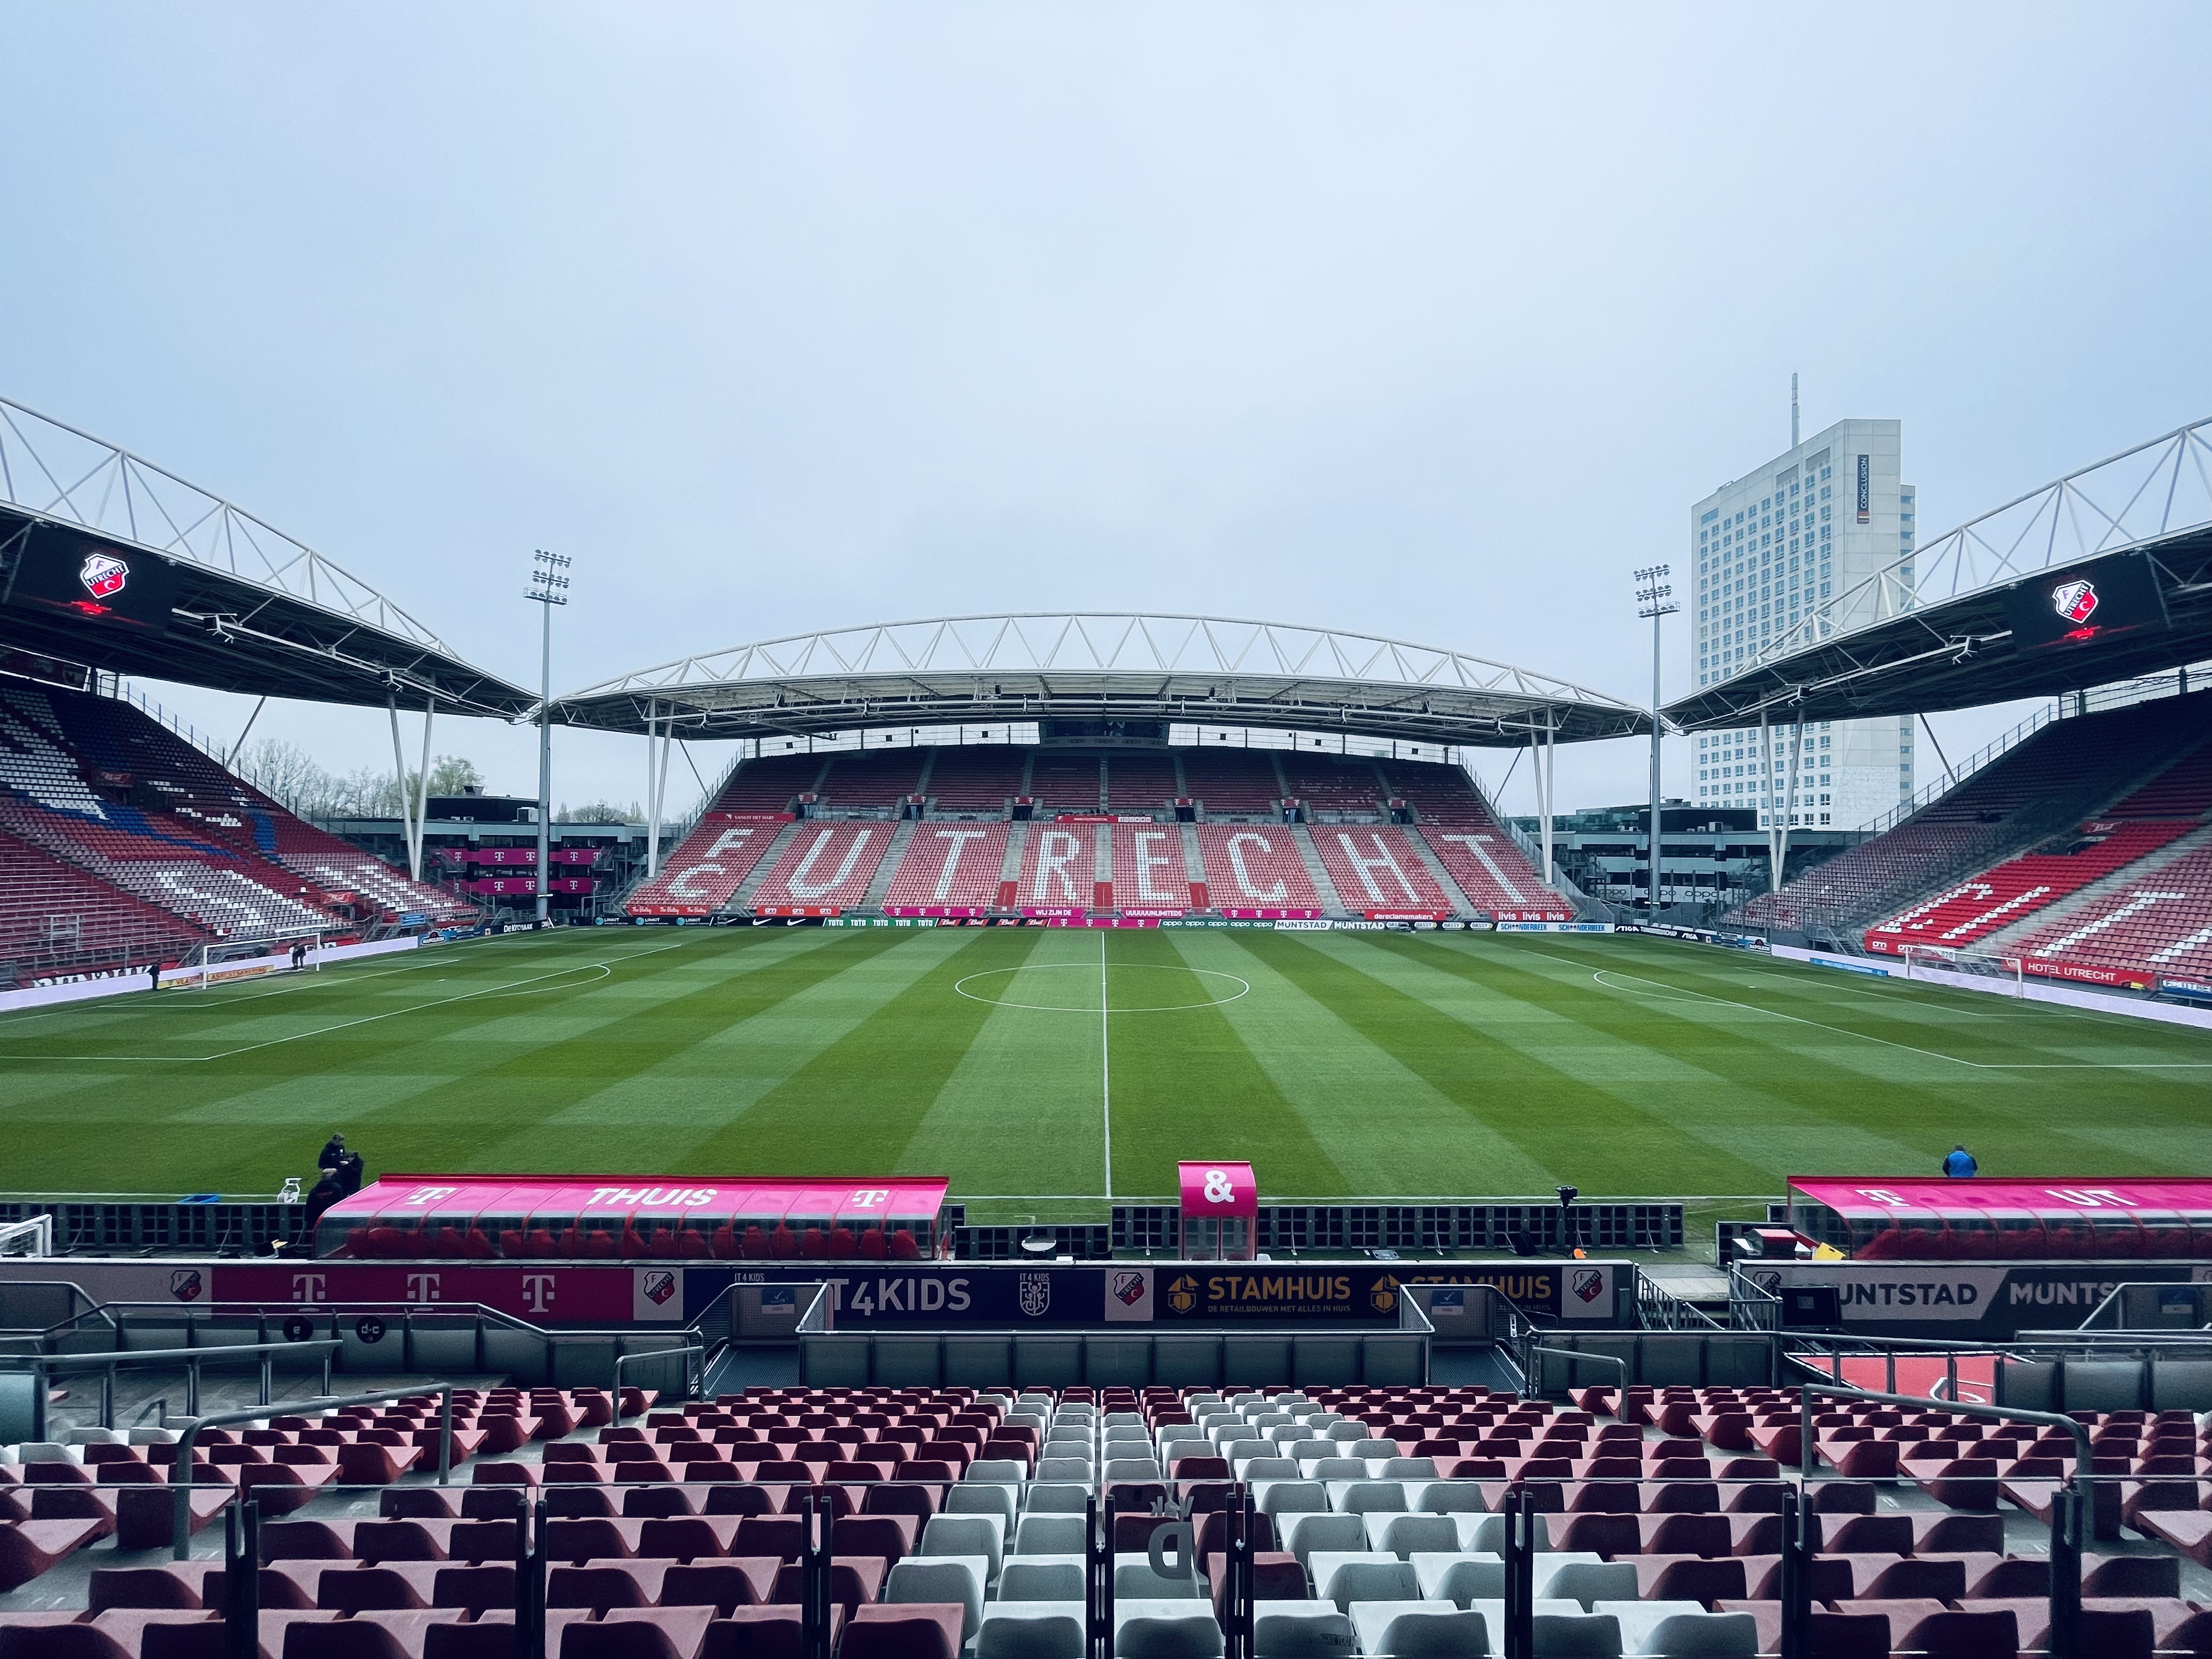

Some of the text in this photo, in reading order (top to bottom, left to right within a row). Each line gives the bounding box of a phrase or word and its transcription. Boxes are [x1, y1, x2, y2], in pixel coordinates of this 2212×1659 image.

[96, 560, 105, 569] F
[86, 565, 124, 586] UTRECHT
[104, 580, 115, 590] C
[2062, 590, 2069, 599] F
[2064, 583, 2089, 616] UTRECHT
[2079, 601, 2090, 611] C
[705, 828, 754, 857] F
[667, 864, 725, 898] C
[1498, 911, 1565, 921] livis livis livis
[1334, 922, 1384, 930] MUNTSTAD
[2028, 962, 2061, 975] HOTEL
[2064, 968, 2116, 981] UTRECHT
[1204, 1170, 1235, 1203] &
[586, 1188, 718, 1206] THUIS
[652, 1274, 657, 1283] F
[735, 1273, 765, 1282] IT 4 KIDS
[1020, 1273, 1049, 1282] IT 4 KIDS
[1121, 1276, 1126, 1284] F
[1580, 1273, 1585, 1281] F
[648, 1274, 672, 1298] UTRECHT
[1118, 1274, 1142, 1299] UTRECHT
[1208, 1277, 1351, 1300] STAMHUIS
[1589, 1286, 1596, 1295] C
[662, 1288, 669, 1297] C
[815, 1278, 970, 1316] T4KIDS
[1131, 1289, 1138, 1297] C
[1839, 1283, 2116, 1305] UNTSTAD MUNTS
